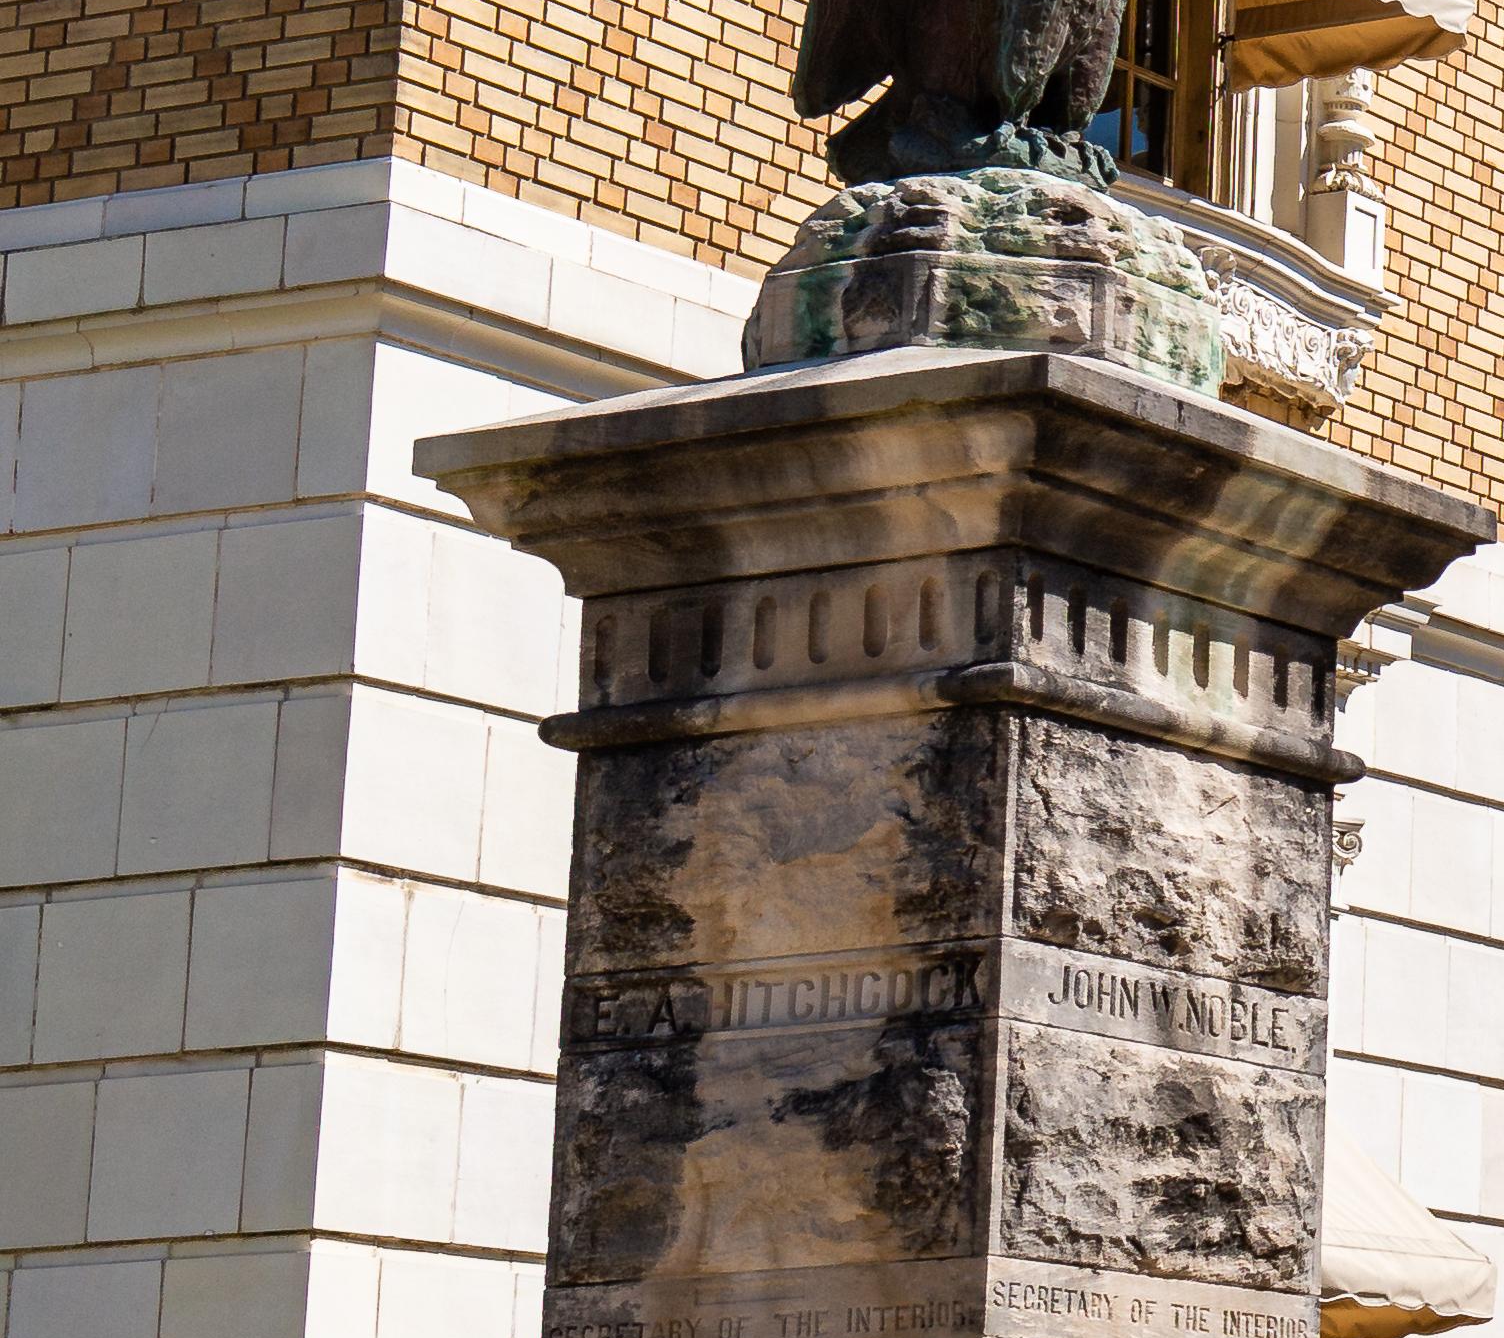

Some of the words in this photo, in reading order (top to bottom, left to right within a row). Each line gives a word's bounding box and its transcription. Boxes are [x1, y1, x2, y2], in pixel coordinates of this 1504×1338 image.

[711, 959, 982, 1028] HITCHCOCK
[1047, 964, 1140, 1019] JOHN
[774, 1308, 829, 1338] THE
[993, 1281, 1119, 1321] SECRETARY
[1131, 1298, 1156, 1325] OF
[1170, 1303, 1210, 1333] THE
